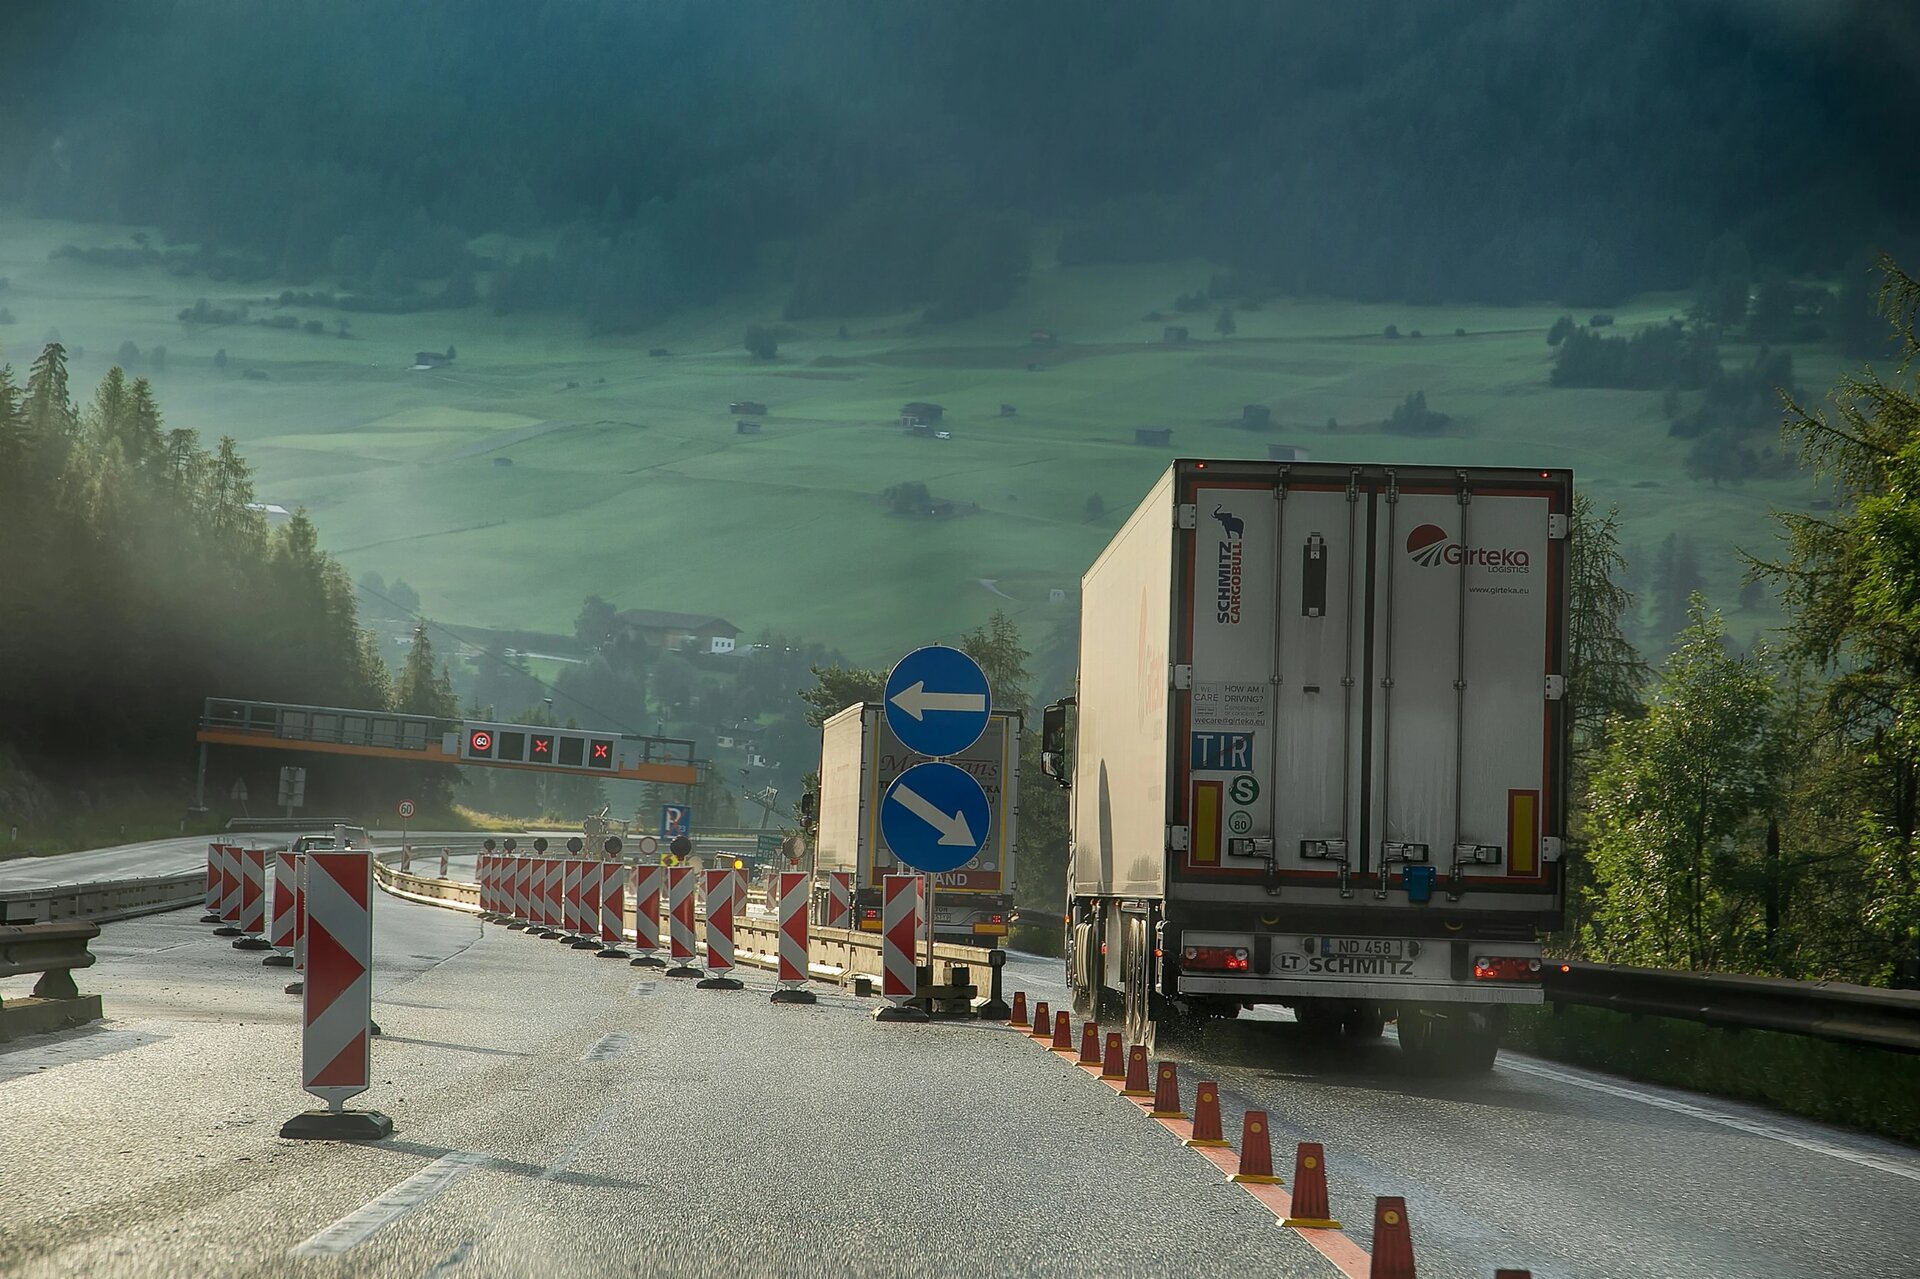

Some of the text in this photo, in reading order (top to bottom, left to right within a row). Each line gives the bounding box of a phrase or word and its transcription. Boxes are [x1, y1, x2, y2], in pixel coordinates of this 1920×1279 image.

[1443, 544, 1530, 566] Girteka
[1488, 566, 1530, 574] LOGISTICS
[1217, 542, 1232, 624] SCHMITZ
[1231, 542, 1242, 624] CARGOBULL
[1469, 586, 1530, 595] www.girteka.eu
[1224, 685, 1245, 693] HOW
[1193, 693, 1219, 702] CARE
[1224, 694, 1264, 703] DRIVING?
[476, 736, 487, 746] 60
[1197, 734, 1248, 768] TIR
[1235, 778, 1255, 803] S
[401, 803, 412, 815] 60
[665, 807, 682, 831] P
[1234, 820, 1247, 831] 80
[1338, 940, 1391, 954] ND 458
[1281, 955, 1300, 969] LT
[1308, 957, 1414, 975] SCHMITZ
